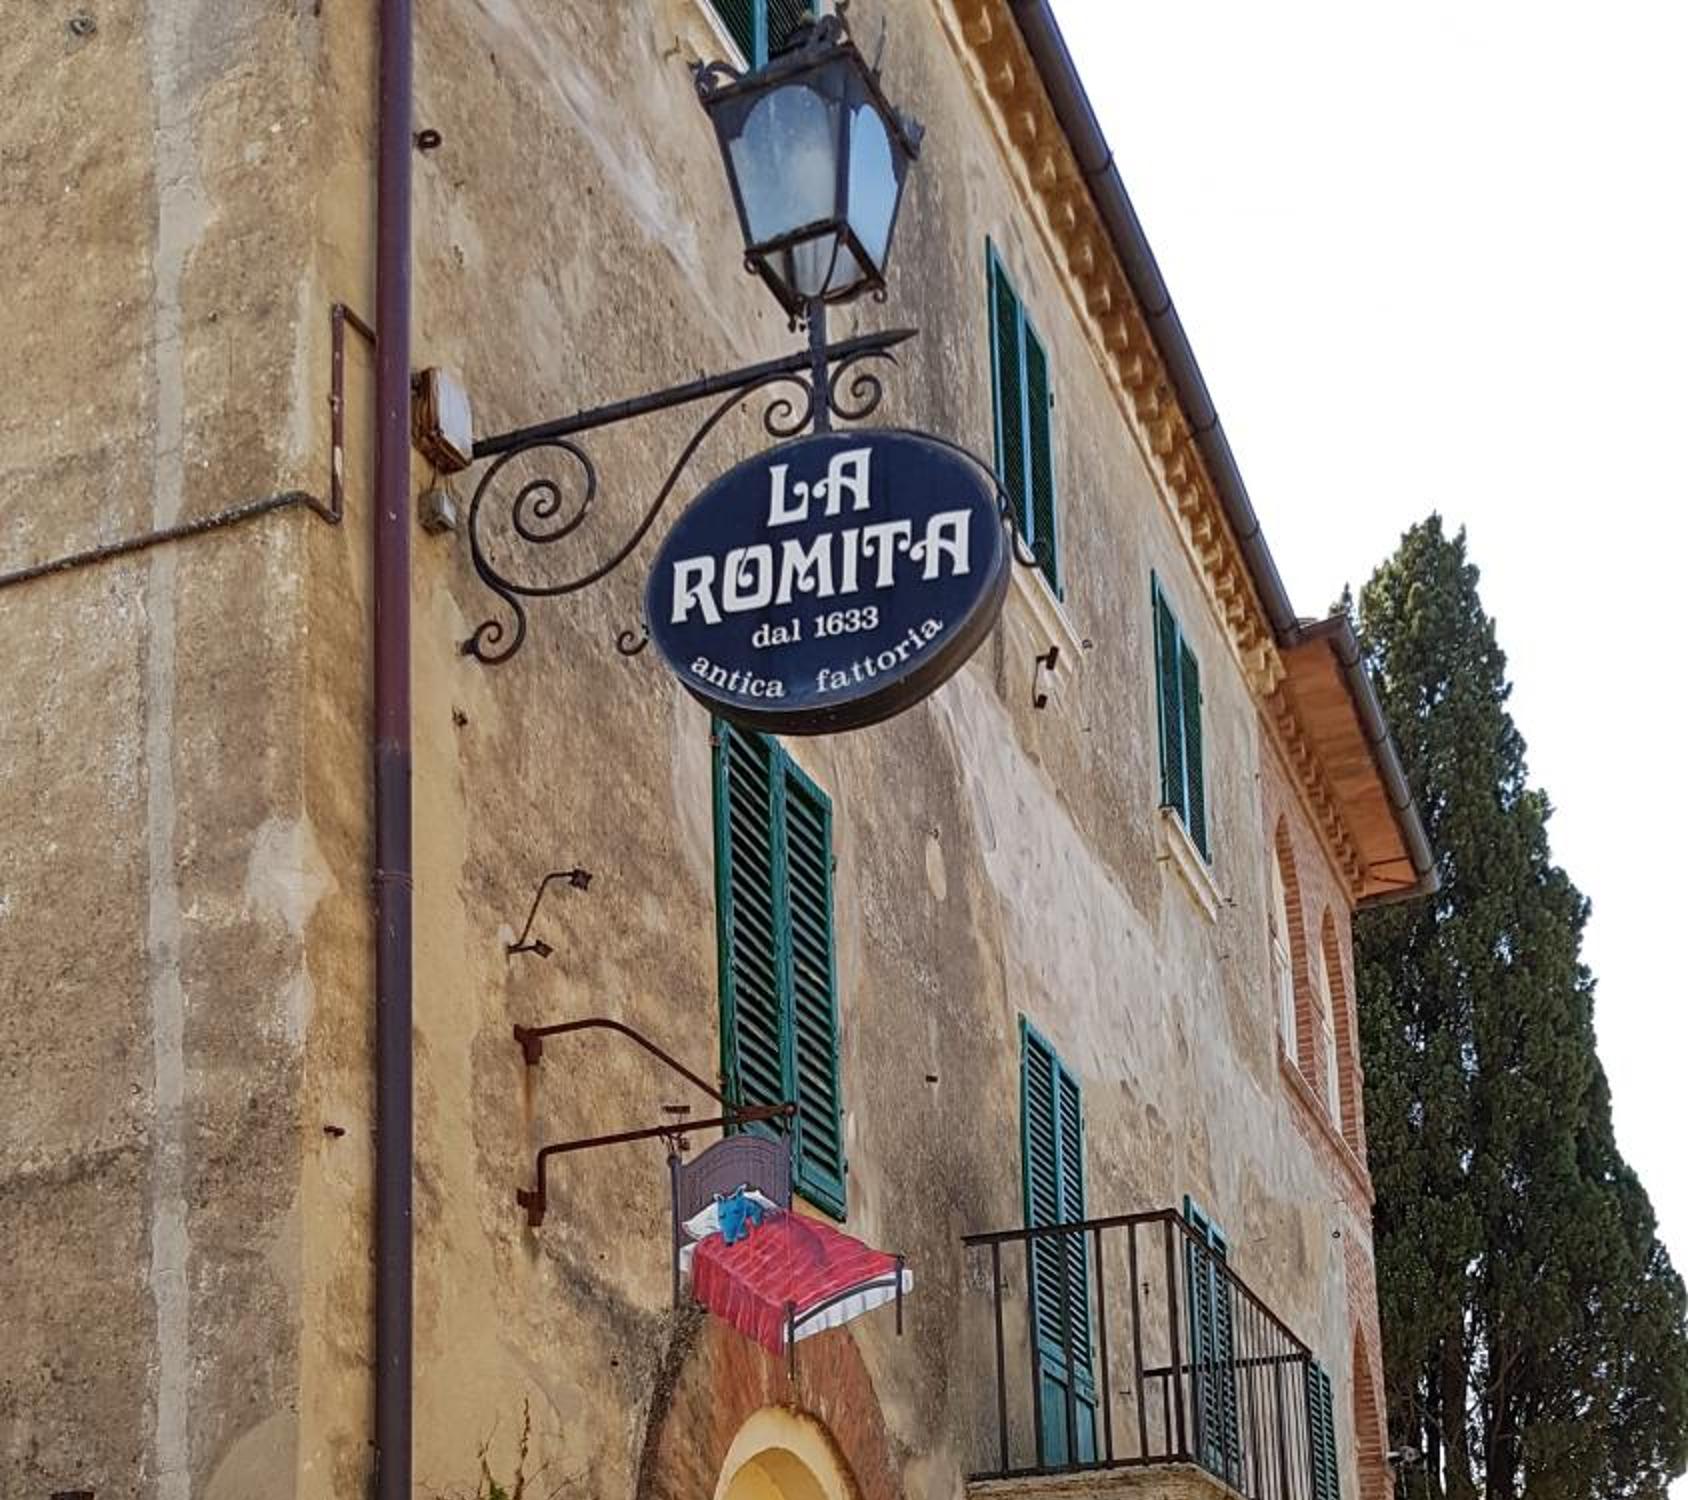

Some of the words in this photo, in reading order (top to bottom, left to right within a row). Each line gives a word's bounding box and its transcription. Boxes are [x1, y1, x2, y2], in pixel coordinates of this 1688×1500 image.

[767, 447, 873, 527] LA
[670, 508, 973, 625] ROMITA
[690, 655, 785, 699] antica
[815, 617, 944, 693] fattoria
[752, 619, 801, 649] dal
[814, 605, 879, 638] 1633
